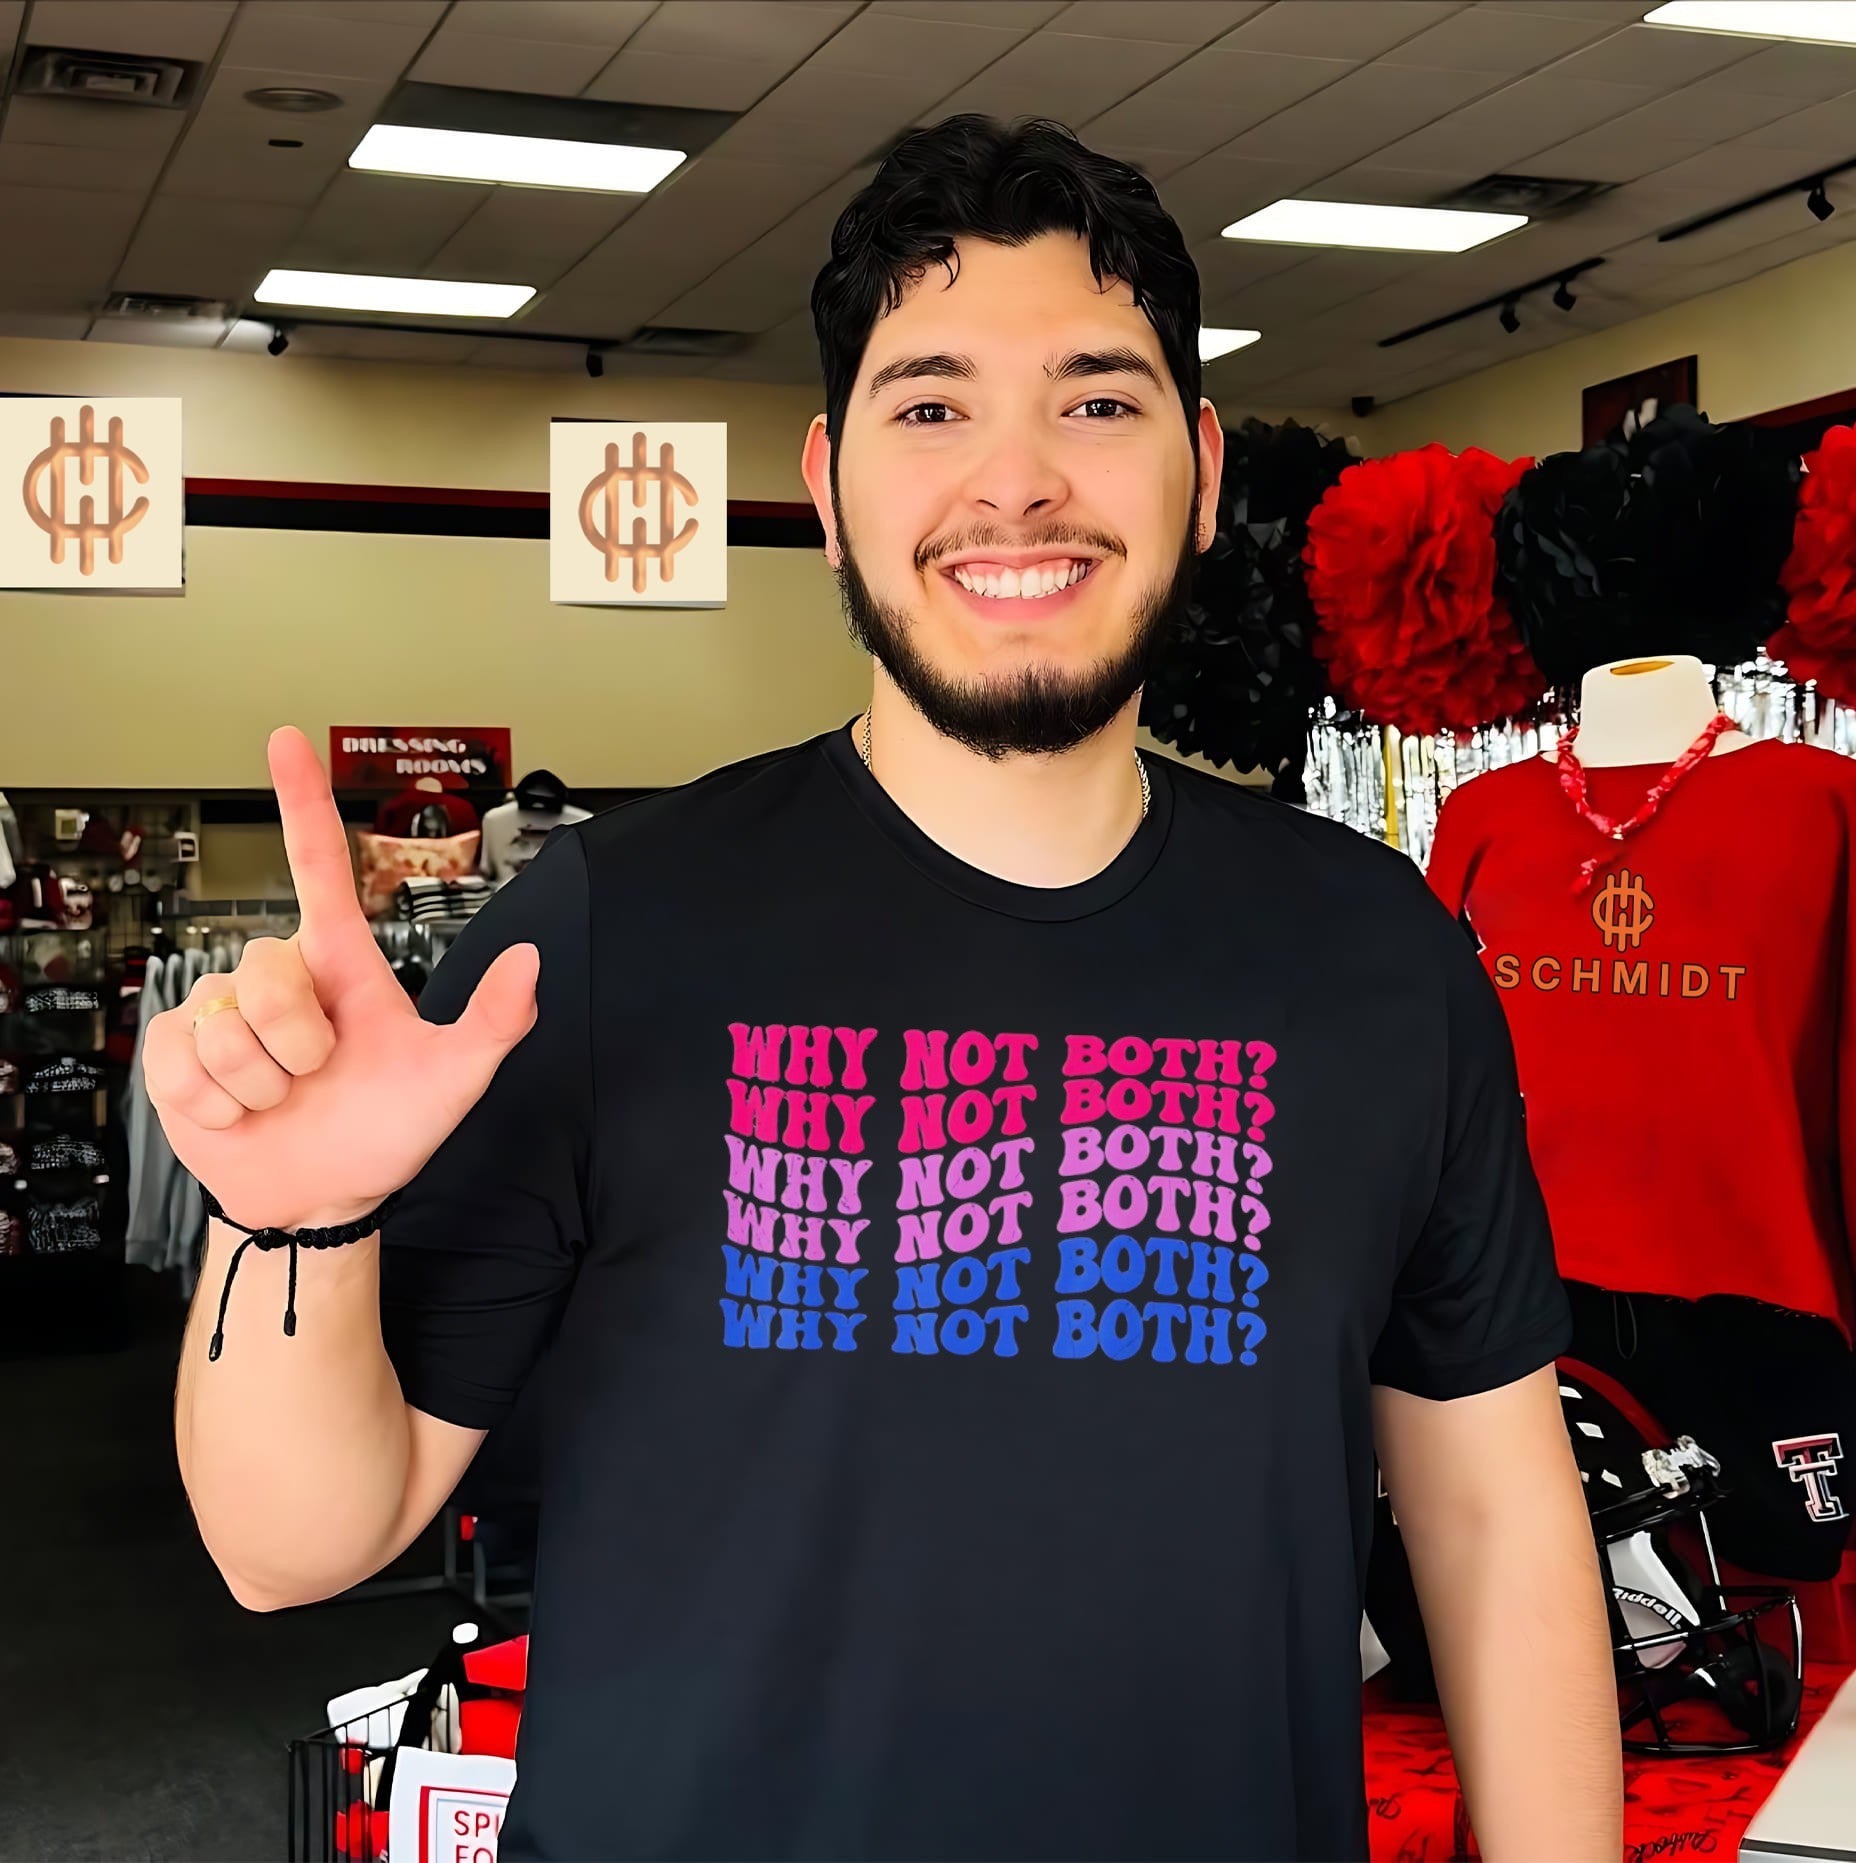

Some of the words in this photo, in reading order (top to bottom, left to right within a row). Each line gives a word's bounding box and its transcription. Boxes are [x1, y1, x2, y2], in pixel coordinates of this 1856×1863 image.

[396, 758, 487, 774] ROOMS
[1494, 953, 1747, 1000] SCHMIDT
[727, 1022, 878, 1090] WHY
[900, 1029, 1039, 1091] NOT
[1061, 1034, 1278, 1090] BOTH?
[725, 1078, 876, 1154] WHY
[898, 1084, 1037, 1153] NOT
[1060, 1078, 1276, 1142] BOTH?
[724, 1134, 873, 1215] WHY
[896, 1137, 1035, 1210] NOT
[1058, 1124, 1273, 1194] BOTH?
[723, 1190, 871, 1264] WHY
[894, 1191, 1033, 1263] NOT
[1056, 1175, 1271, 1251] BOTH?
[721, 1245, 869, 1310] WHY
[892, 1247, 1031, 1311] NOT
[1054, 1235, 1270, 1308] BOTH?
[719, 1299, 867, 1352] WHY
[891, 1304, 1029, 1357] NOT
[1052, 1299, 1268, 1366] BOTH?
